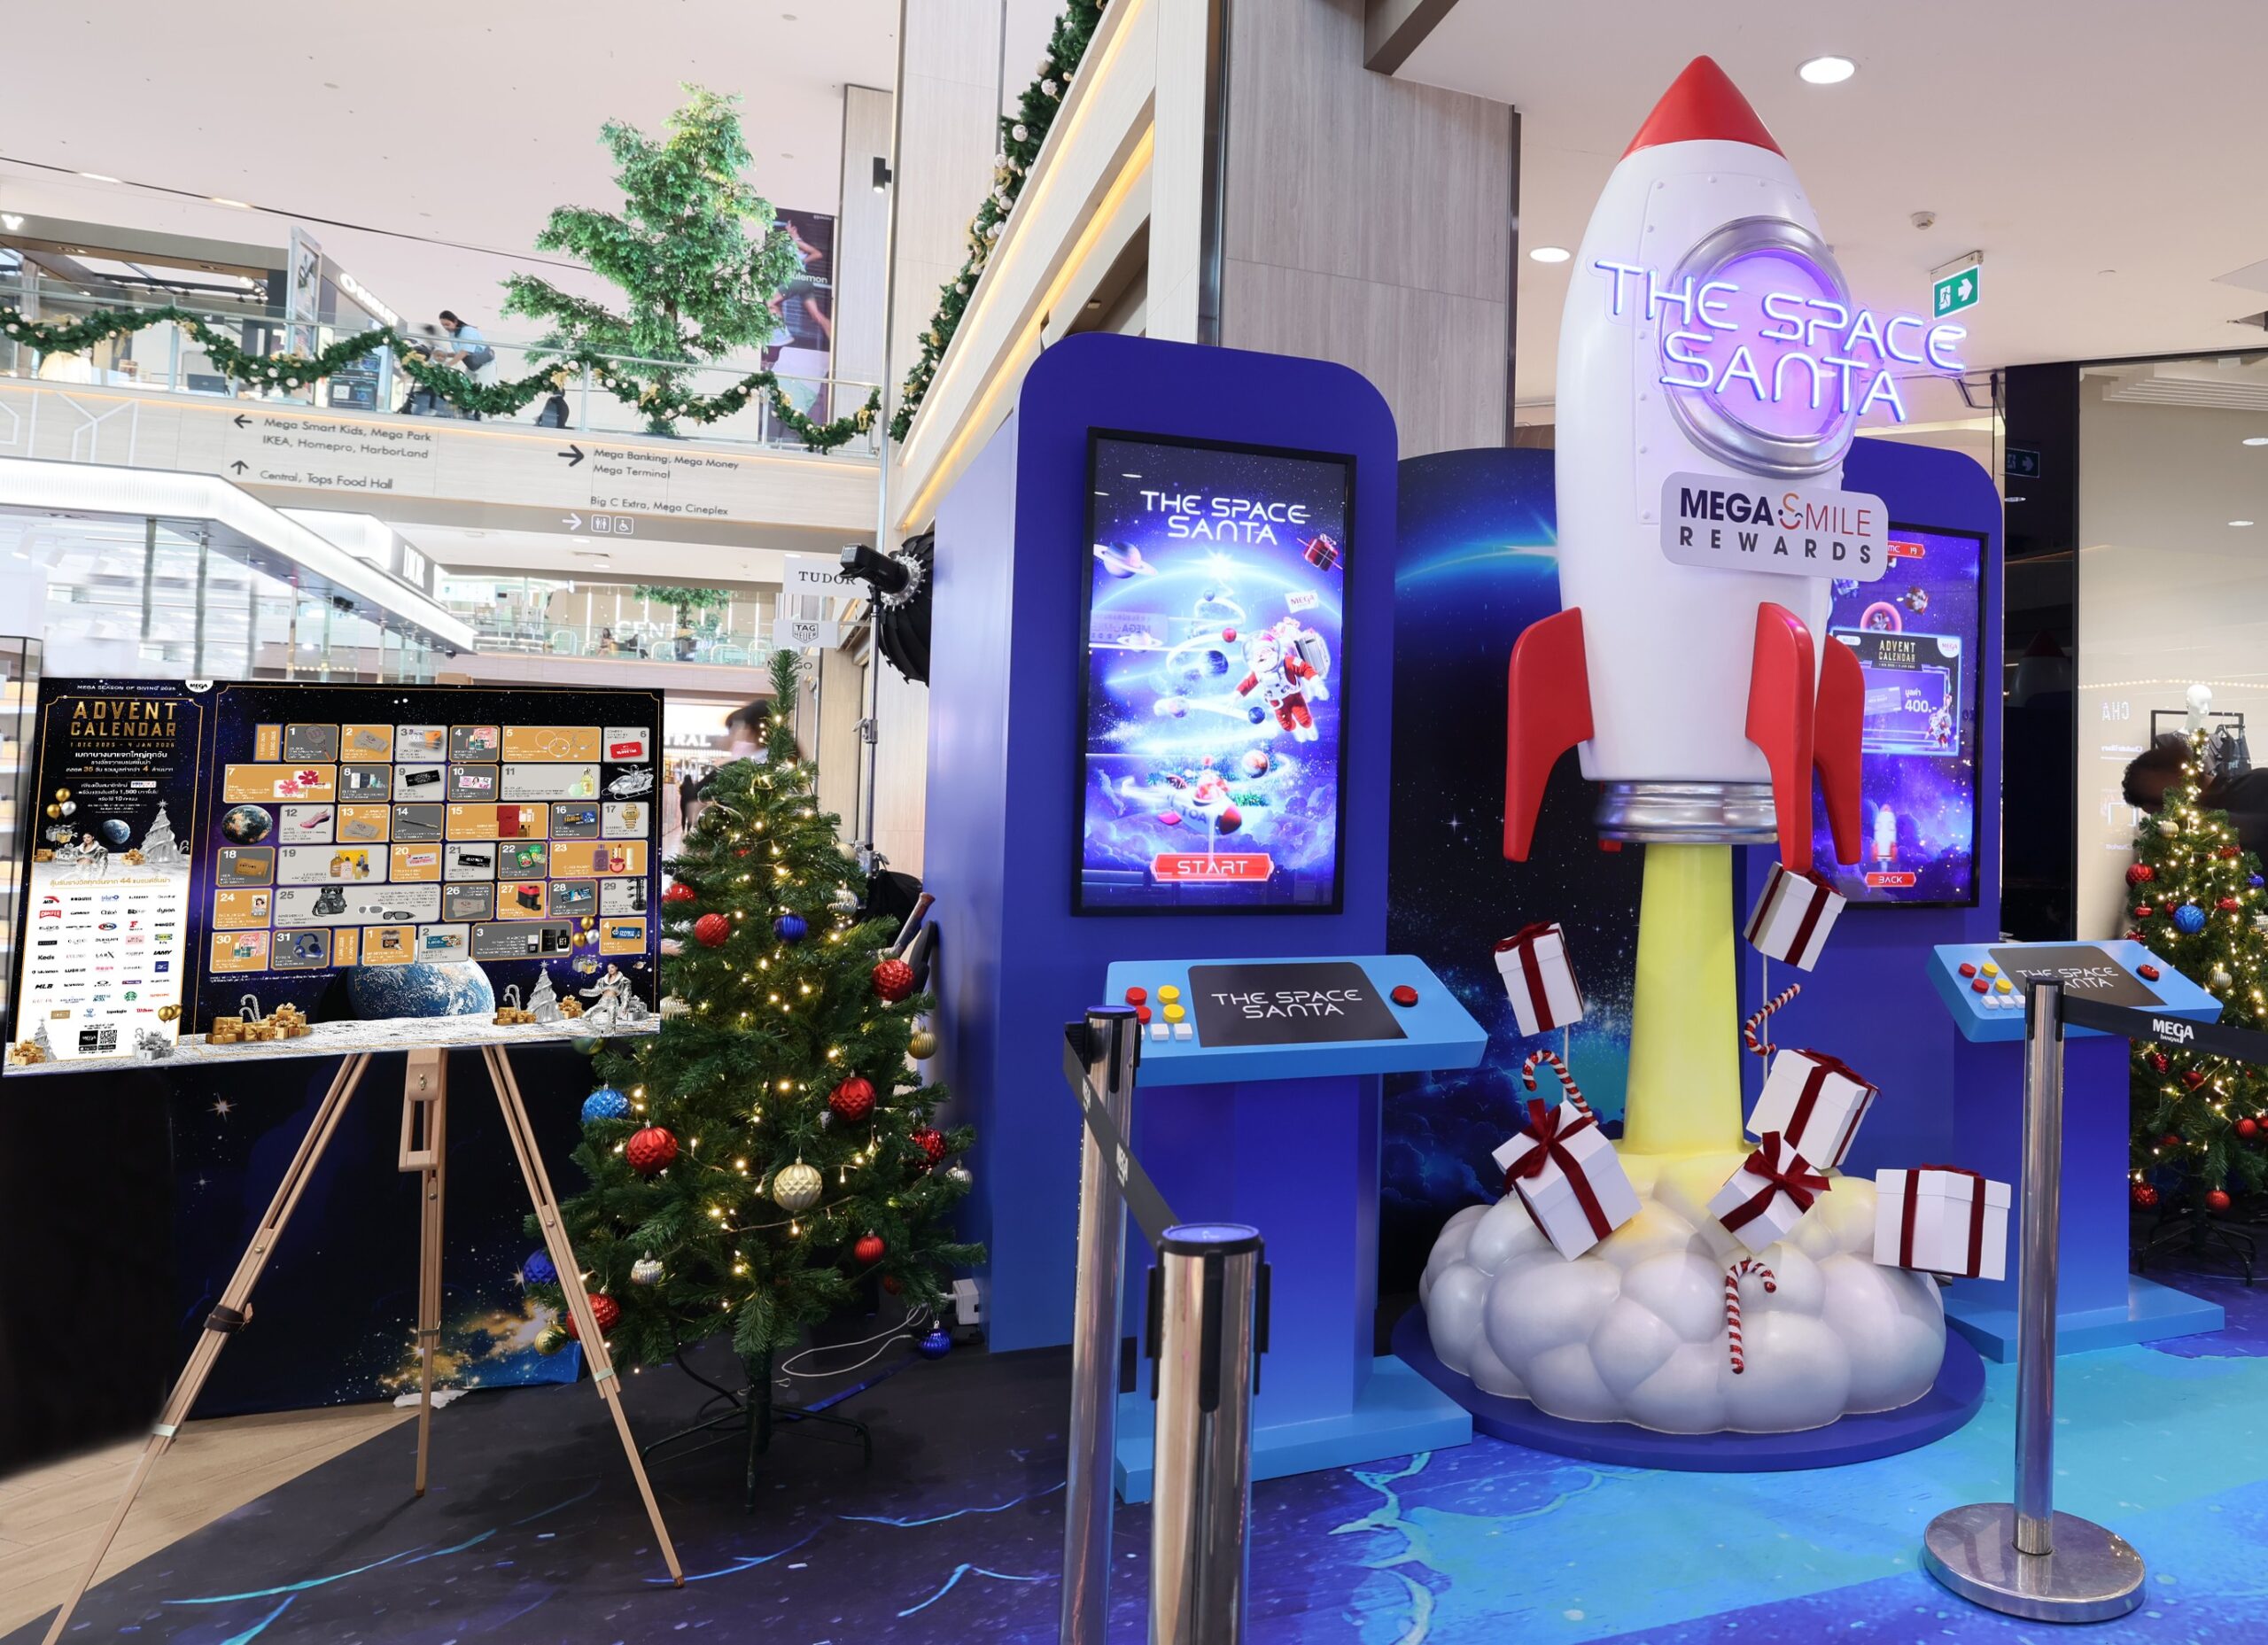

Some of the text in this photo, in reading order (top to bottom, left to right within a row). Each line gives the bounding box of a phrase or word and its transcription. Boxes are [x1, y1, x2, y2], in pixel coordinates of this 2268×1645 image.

[1595, 260, 1967, 370] THE SPACE
[1659, 330, 1907, 423] SANTA
[264, 418, 432, 442] Mega Smart Kids, Mega Park
[262, 435, 429, 459] IKEA, Homepro, HarborLand
[594, 448, 740, 470] Mega Banking, Mega Money
[593, 464, 671, 479] Mega Terminal
[260, 470, 393, 489] Central, Tops Food Hall
[590, 496, 728, 517] Big C Extra, Mega Cineplex
[1139, 491, 1311, 524] THE SPACE
[1680, 487, 1775, 526] MEGA
[1167, 516, 1278, 545] SANTA
[1680, 526, 1871, 564] REWARDS
[798, 570, 857, 586] TUDOR
[1879, 640, 1916, 653] ADVENT
[1878, 652, 1915, 663] CALENDAR
[73, 702, 177, 720] ADVENT
[71, 721, 175, 737] CALENDAR
[507, 728, 513, 737] 5
[228, 767, 236, 776] 7
[454, 767, 464, 776] 10
[505, 767, 516, 776] 11
[340, 808, 353, 817] 13
[450, 806, 462, 815] 15
[282, 849, 296, 857] 19
[555, 843, 568, 852] 23
[1177, 861, 1248, 874] START
[1878, 874, 1903, 884] BACK
[447, 886, 461, 895] 26
[553, 883, 567, 892] 28
[220, 893, 236, 902] 24
[280, 891, 294, 900] 25
[216, 935, 232, 944] 30
[276, 933, 291, 942] 31
[368, 930, 373, 939] 1
[2058, 966, 2118, 978] SPACE
[2064, 977, 2114, 989] ANTA
[1211, 989, 1363, 1005] THE SPACE
[1242, 1003, 1345, 1019] SANTA
[2153, 1019, 2194, 1044] MEGA
